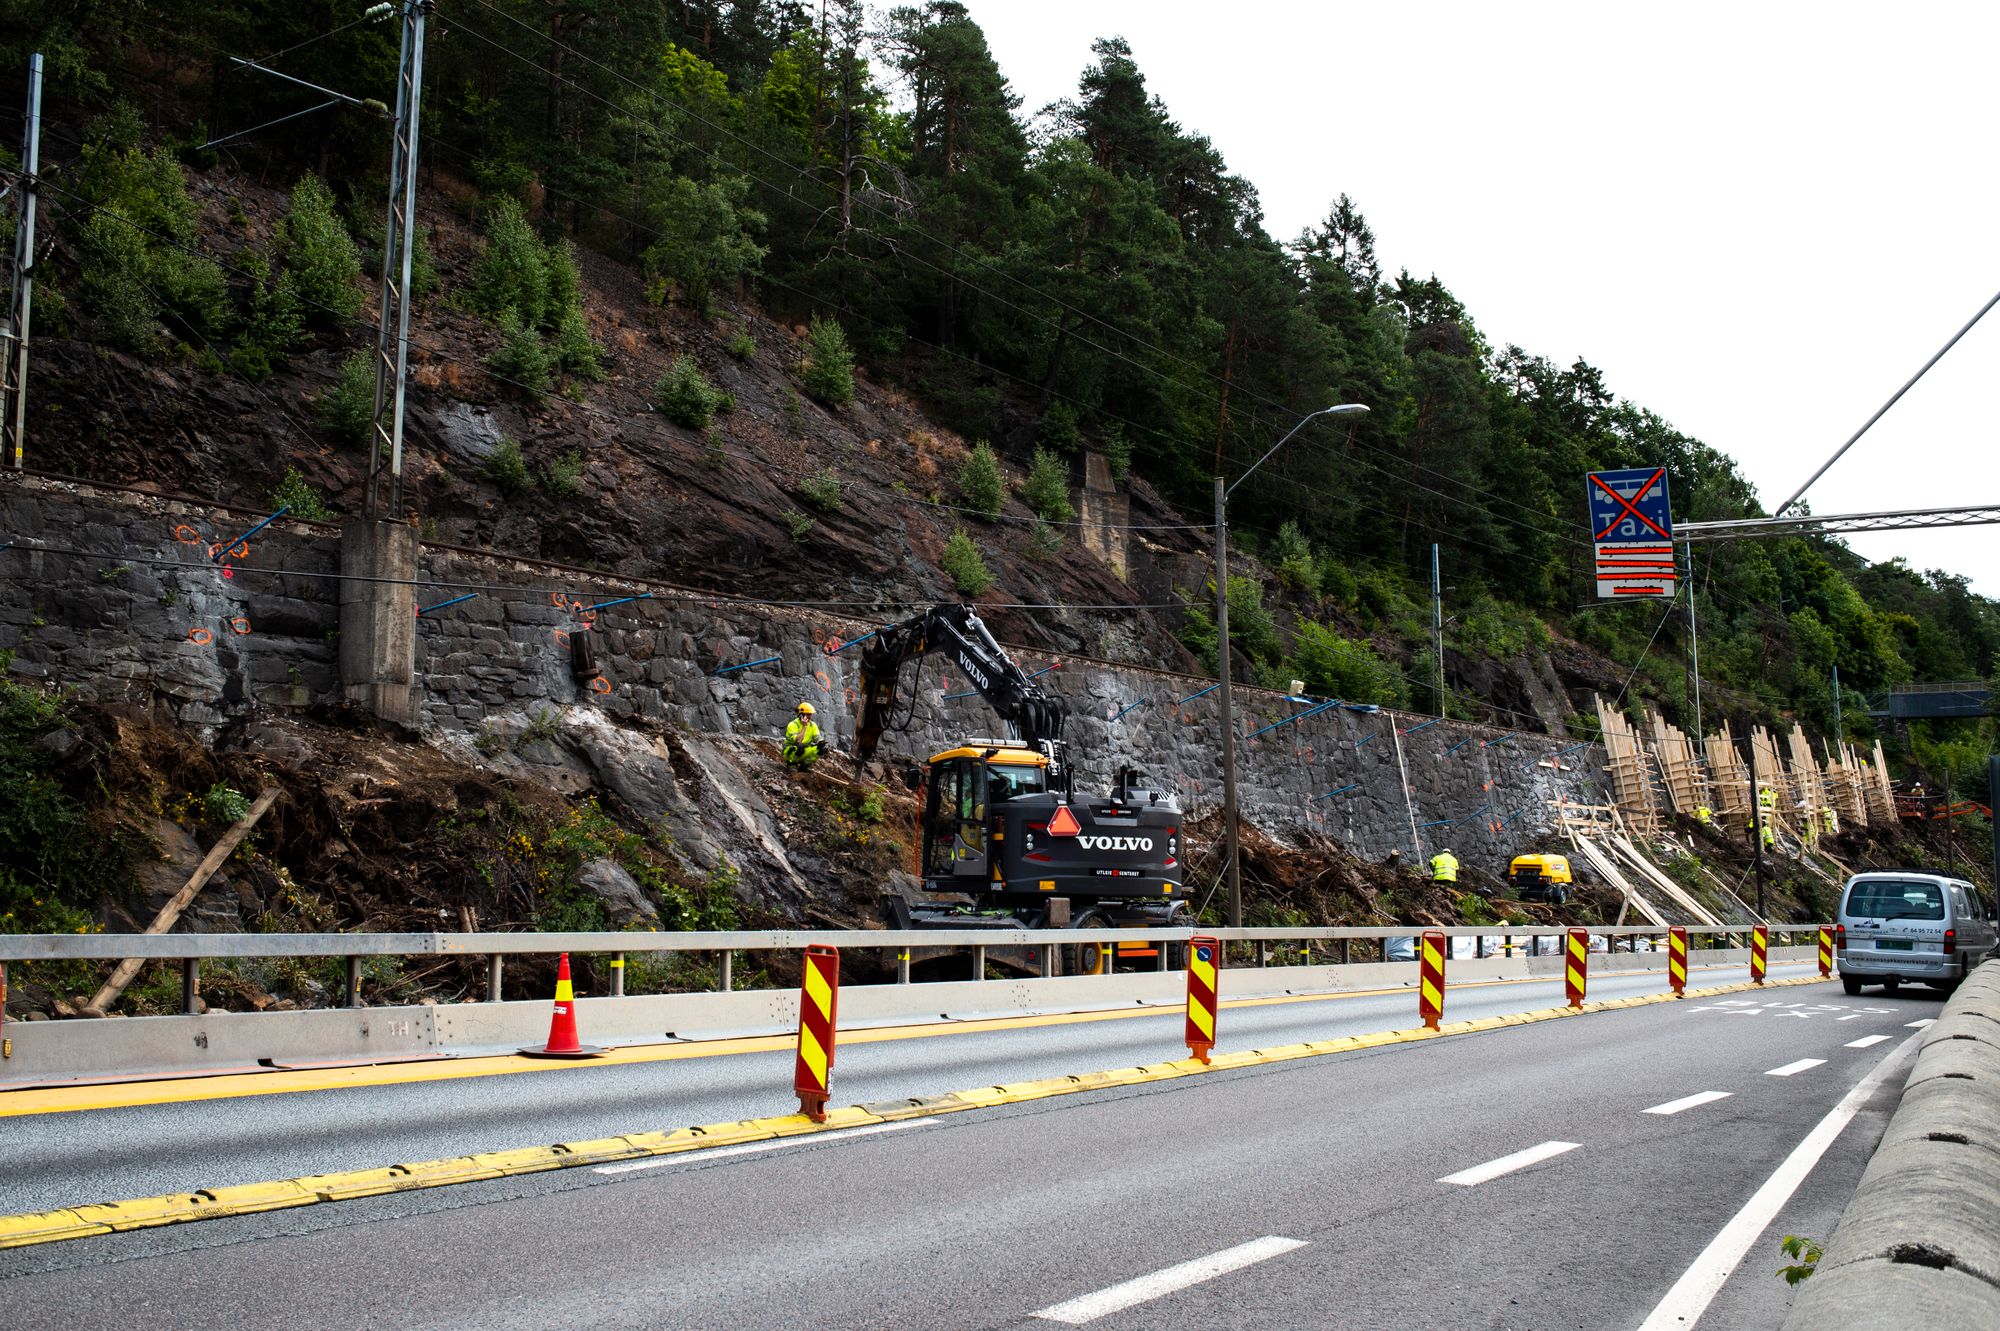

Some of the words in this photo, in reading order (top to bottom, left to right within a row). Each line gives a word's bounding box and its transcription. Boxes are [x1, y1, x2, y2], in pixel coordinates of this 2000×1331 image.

[1599, 510, 1664, 537] Taxi
[960, 650, 989, 690] VOLVO
[1076, 836, 1153, 851] VOLVO
[1687, 1006, 1862, 1021] TAXI
[1712, 1001, 1899, 1014] BUSS
